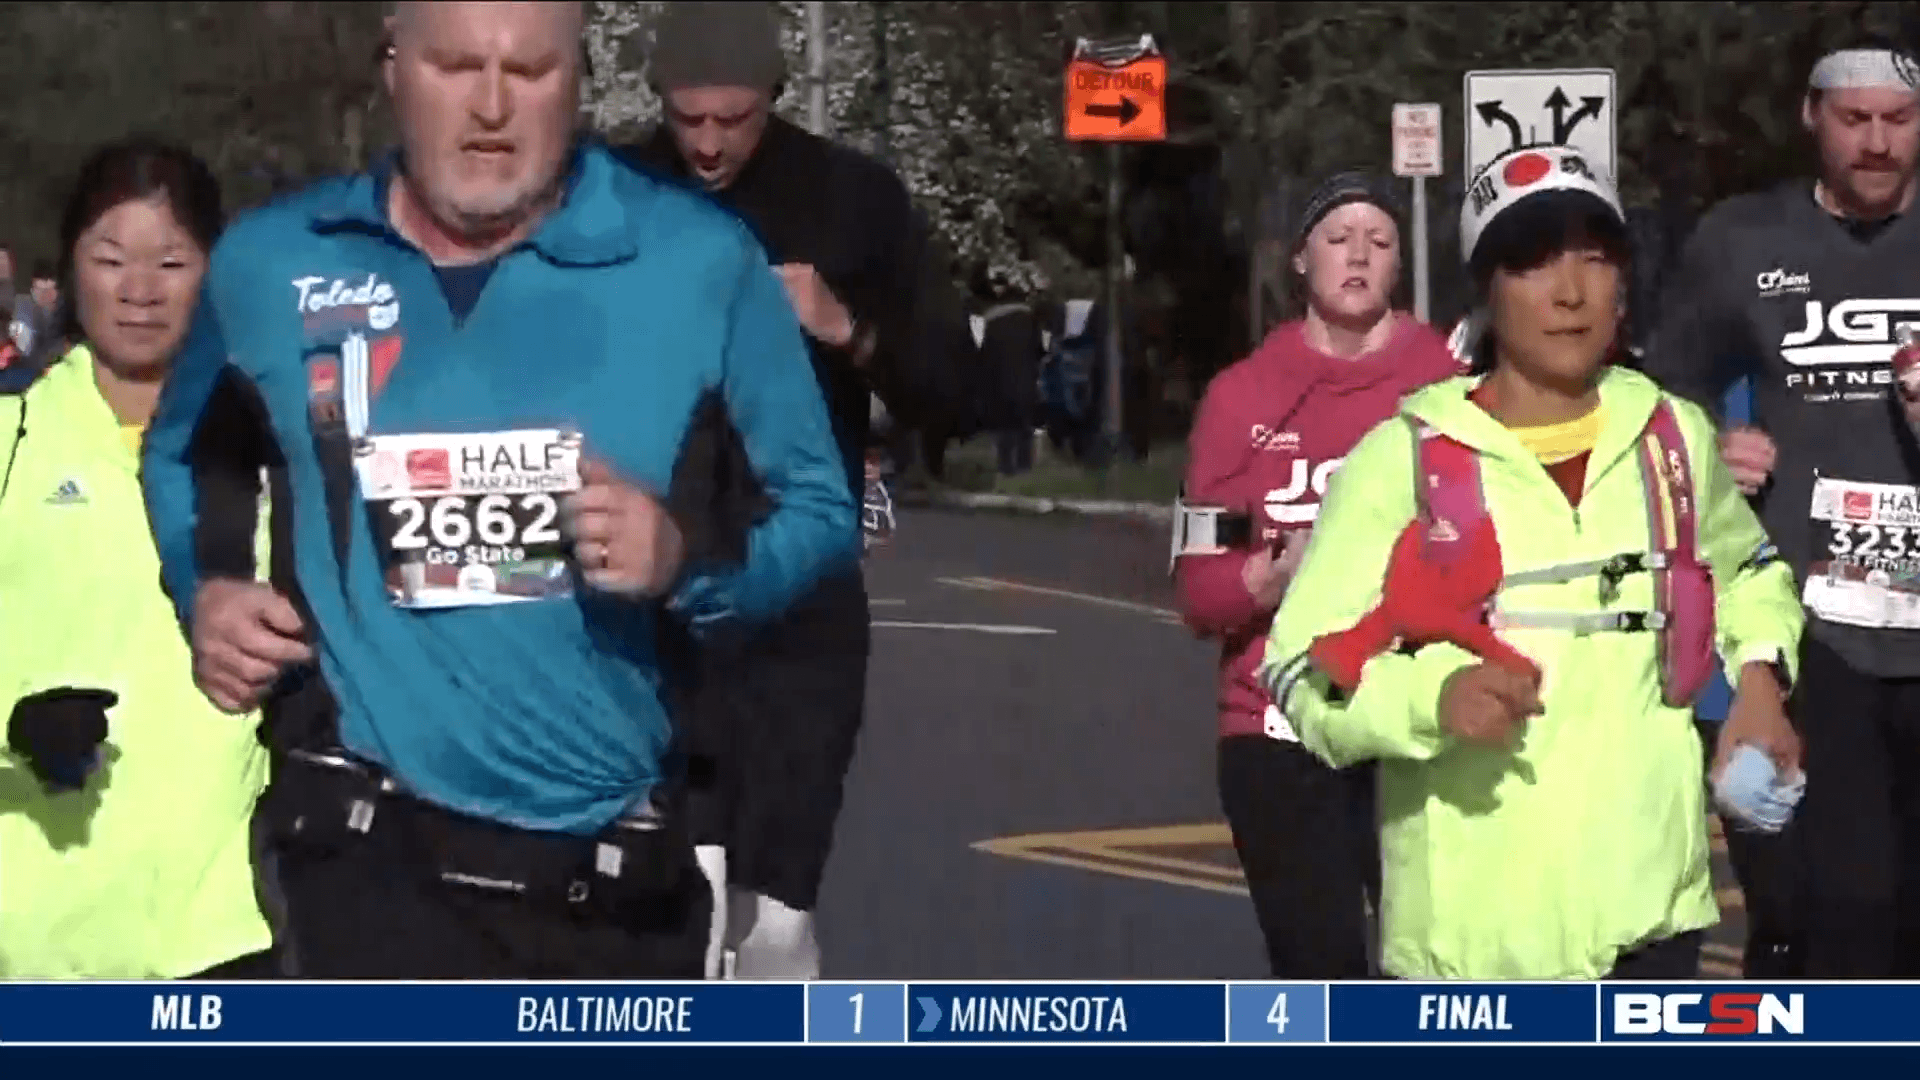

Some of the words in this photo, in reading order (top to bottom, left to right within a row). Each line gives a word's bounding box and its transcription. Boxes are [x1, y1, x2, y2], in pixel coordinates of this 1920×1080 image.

[1076, 69, 1154, 91] DETOUR
[291, 272, 395, 313] Toledo
[460, 442, 564, 473] HALF
[458, 473, 569, 490] MARATHON
[388, 493, 561, 549] 2662
[426, 546, 459, 564] Go
[464, 545, 525, 564] State
